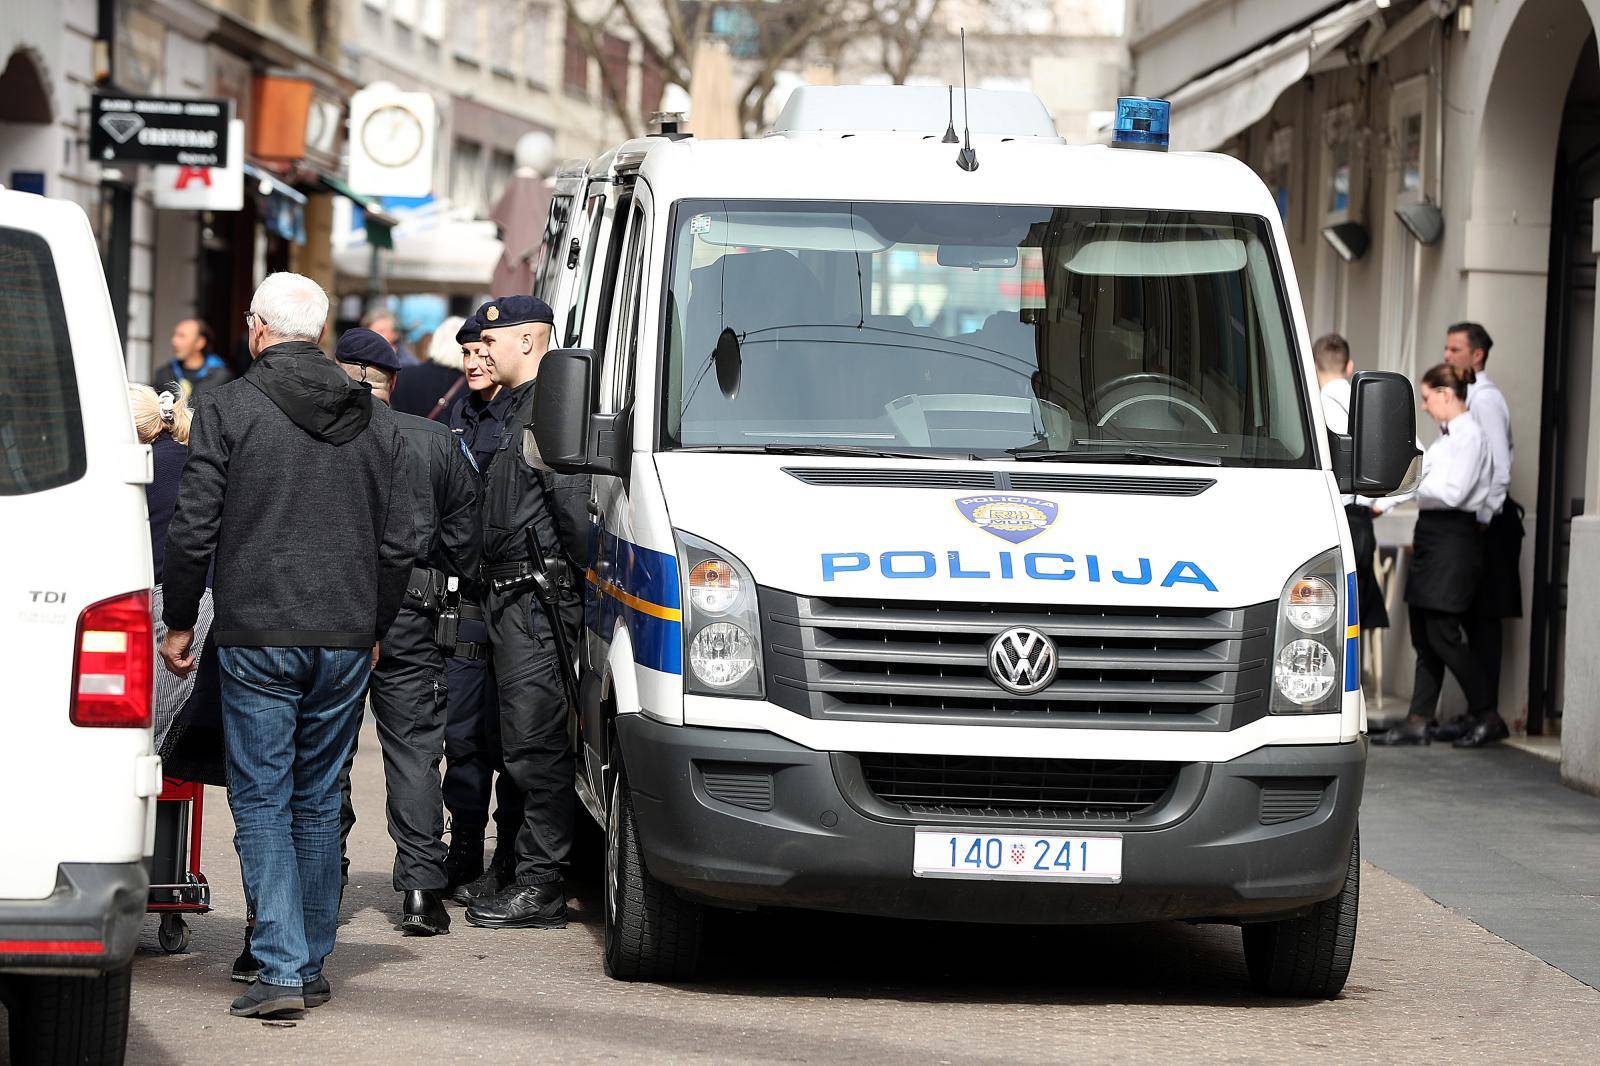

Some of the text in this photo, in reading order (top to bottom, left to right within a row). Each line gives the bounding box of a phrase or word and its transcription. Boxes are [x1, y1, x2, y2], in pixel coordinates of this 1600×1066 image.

[961, 496, 1055, 508] POLICIJA
[821, 551, 1219, 592] POLICIJA
[29, 591, 67, 603] TDI
[949, 837, 1087, 872] 140 241
